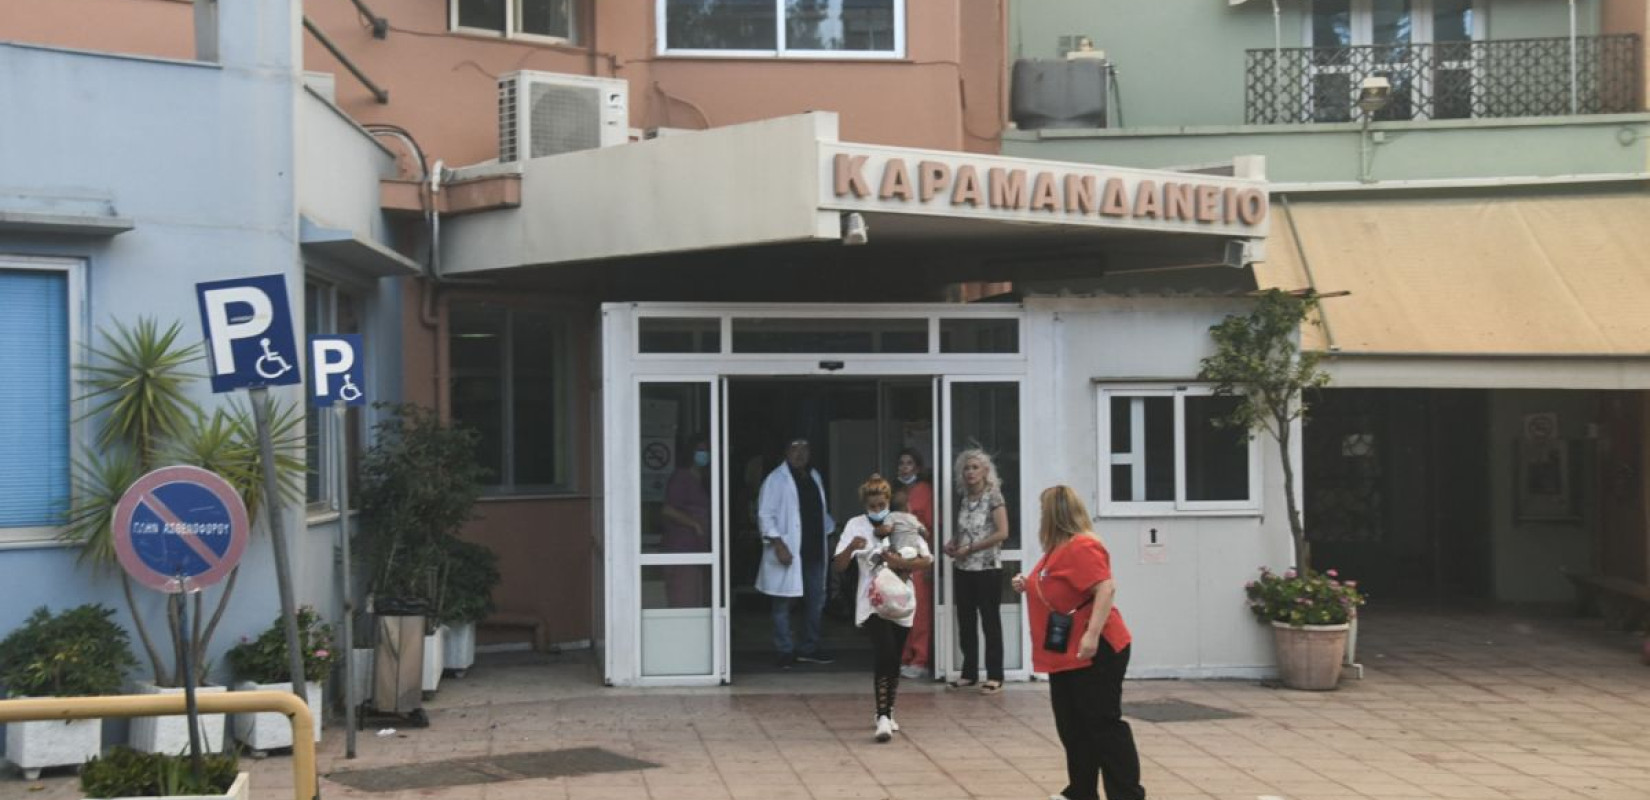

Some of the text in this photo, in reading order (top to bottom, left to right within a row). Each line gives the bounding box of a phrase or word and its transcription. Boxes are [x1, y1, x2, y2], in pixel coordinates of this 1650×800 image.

[834, 153, 1267, 226] ΚΑΡΑΜΑΝΔΑΝΕΙΟ
[204, 286, 273, 375] P
[313, 339, 354, 396] P
